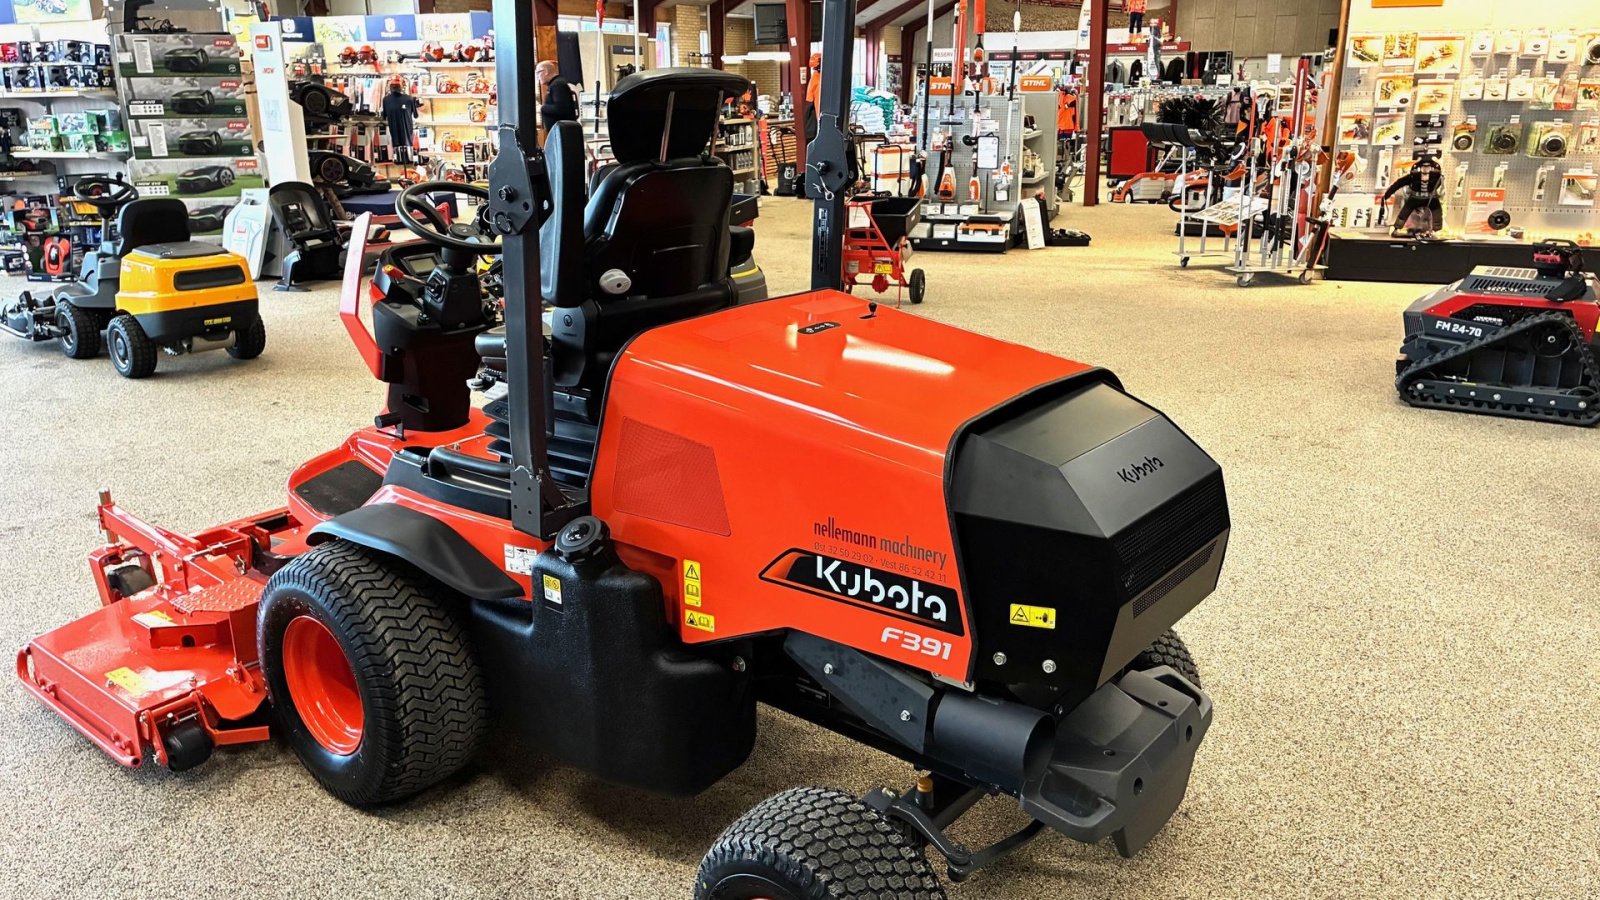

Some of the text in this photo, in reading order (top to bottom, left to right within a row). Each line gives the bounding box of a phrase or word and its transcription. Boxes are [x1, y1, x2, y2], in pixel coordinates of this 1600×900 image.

[1022, 79, 1047, 87] STIHL
[1435, 320, 1482, 337] FM 24-70
[1116, 456, 1164, 483] Kubota
[814, 516, 947, 570] nellemann machinery
[840, 547, 850, 558] 50
[851, 551, 862, 561] 29
[863, 553, 874, 563] 02
[911, 566, 922, 577] 52
[924, 569, 935, 580] 42
[816, 555, 947, 622] Kubota
[880, 627, 953, 661] F391
